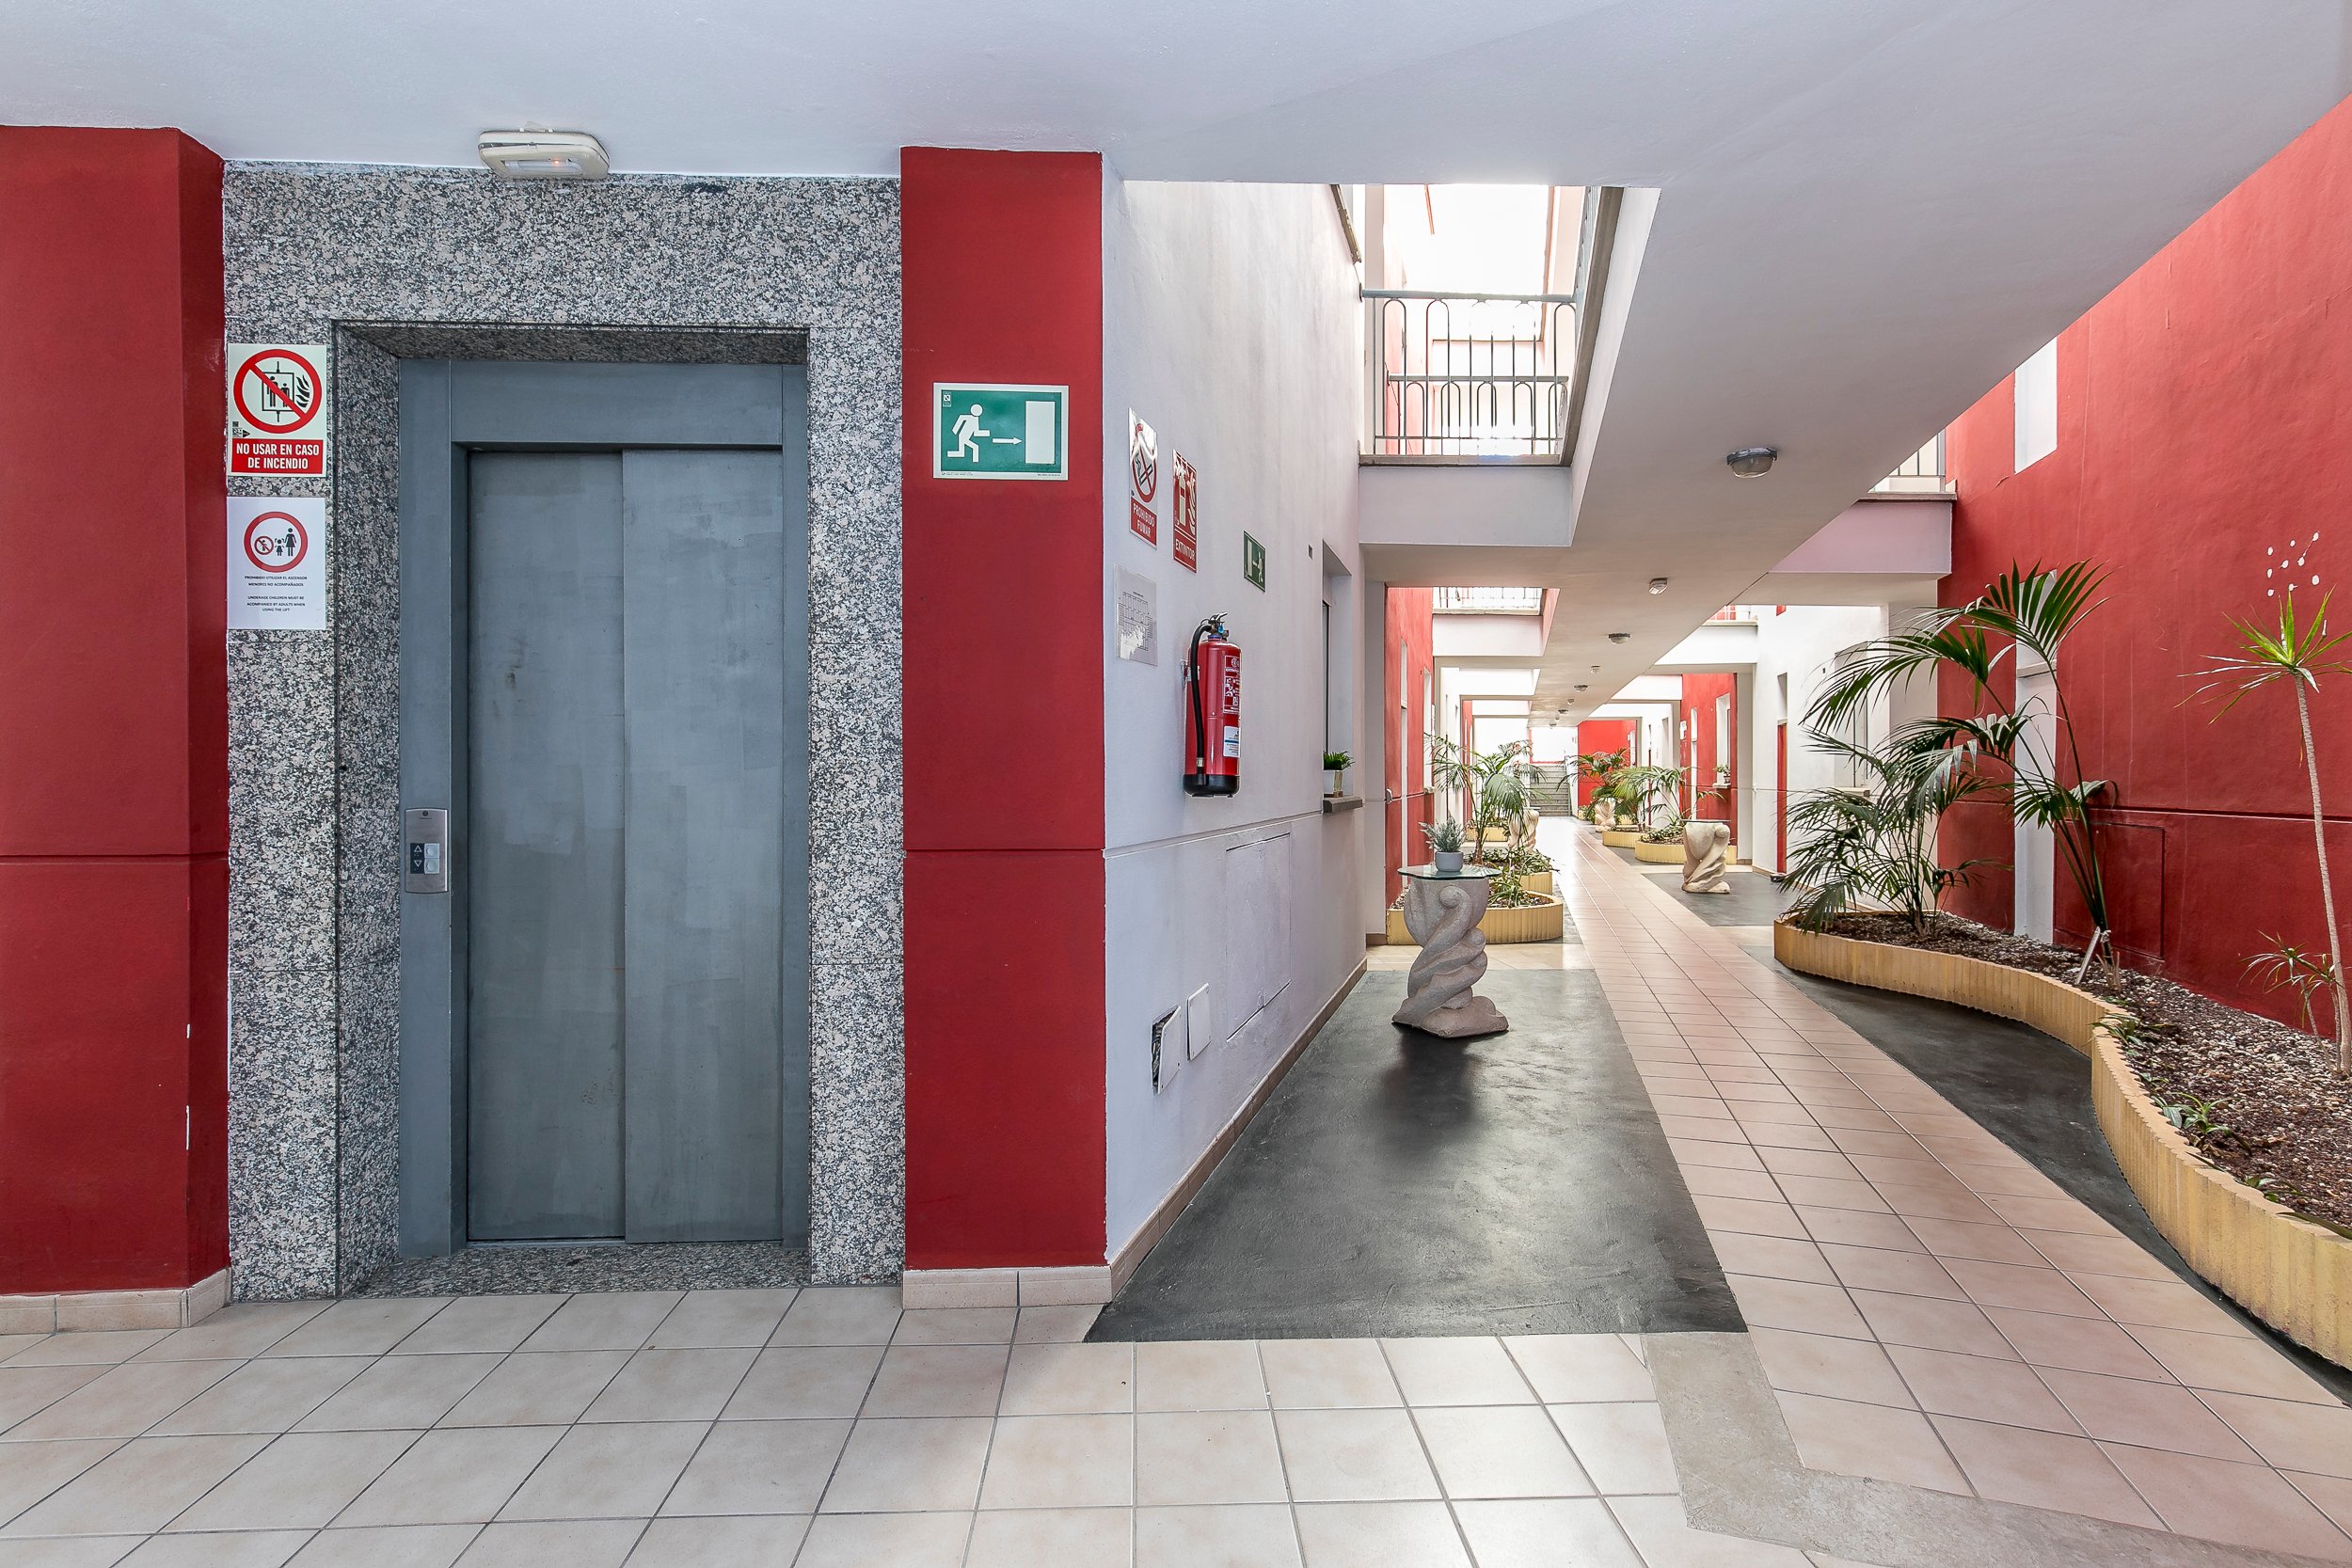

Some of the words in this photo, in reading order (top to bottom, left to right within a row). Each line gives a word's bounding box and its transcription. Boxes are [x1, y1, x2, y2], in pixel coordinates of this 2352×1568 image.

[236, 443, 249, 454] NO
[252, 443, 278, 455] USAR
[280, 444, 292, 455] EN
[295, 444, 320, 455] CASO
[247, 457, 261, 468] DE
[263, 457, 309, 469] INCENDIO
[1133, 502, 1155, 527] PROHIBIDO
[1136, 519, 1152, 538] FUMAR
[1175, 538, 1196, 562] EXTINTOR
